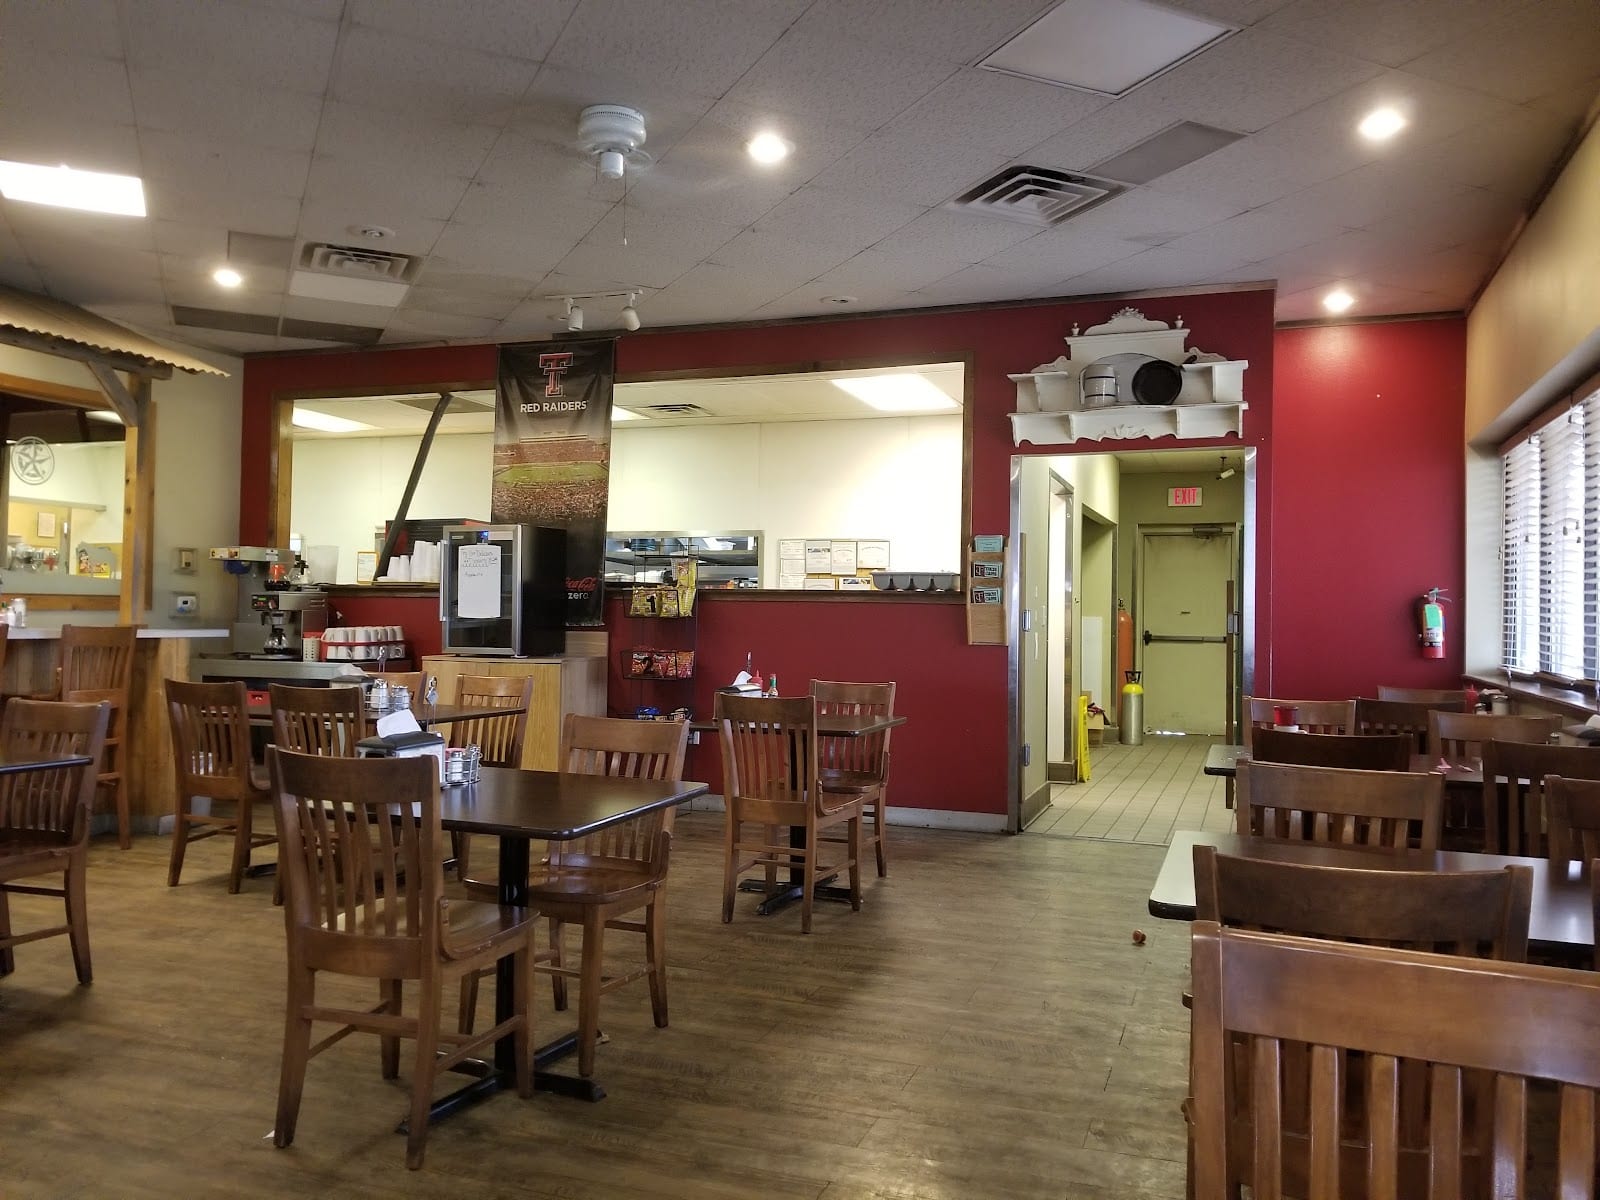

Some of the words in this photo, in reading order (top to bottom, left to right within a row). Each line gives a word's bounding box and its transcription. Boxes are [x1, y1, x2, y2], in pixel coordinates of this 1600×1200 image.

[520, 403, 540, 413] RED
[542, 401, 587, 412] RAIDERS
[1174, 487, 1197, 505] EXIT
[567, 592, 588, 600] zero
